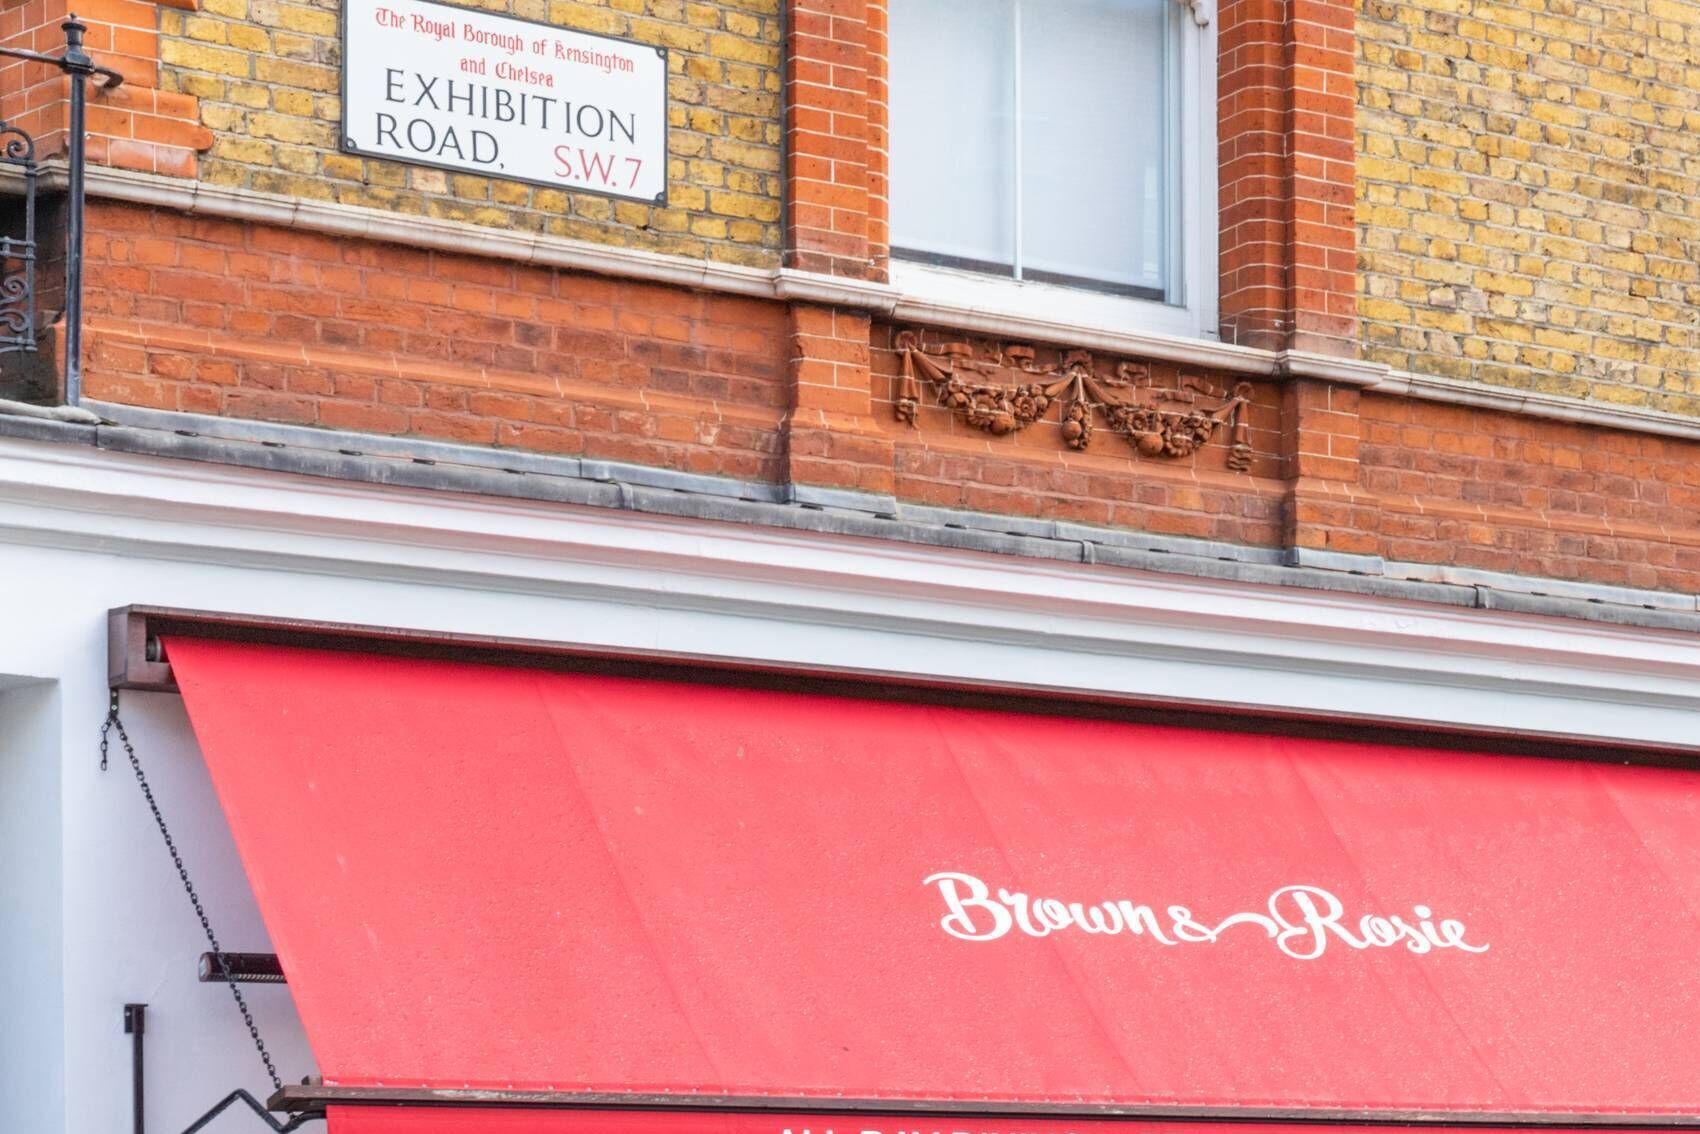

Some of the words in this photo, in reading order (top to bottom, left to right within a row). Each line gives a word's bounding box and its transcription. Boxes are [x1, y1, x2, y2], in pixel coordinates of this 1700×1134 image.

[375, 8, 406, 30] The
[410, 14, 455, 42] Royal
[463, 24, 524, 55] Borough
[532, 39, 547, 56] of
[555, 40, 634, 74] Kensington
[460, 57, 486, 76] and
[495, 61, 554, 88] Chelsea
[385, 67, 637, 145] EXHIBITION
[375, 112, 505, 170] ROAD,
[922, 871, 1180, 945] Brown
[1268, 884, 1491, 960] Rosie
